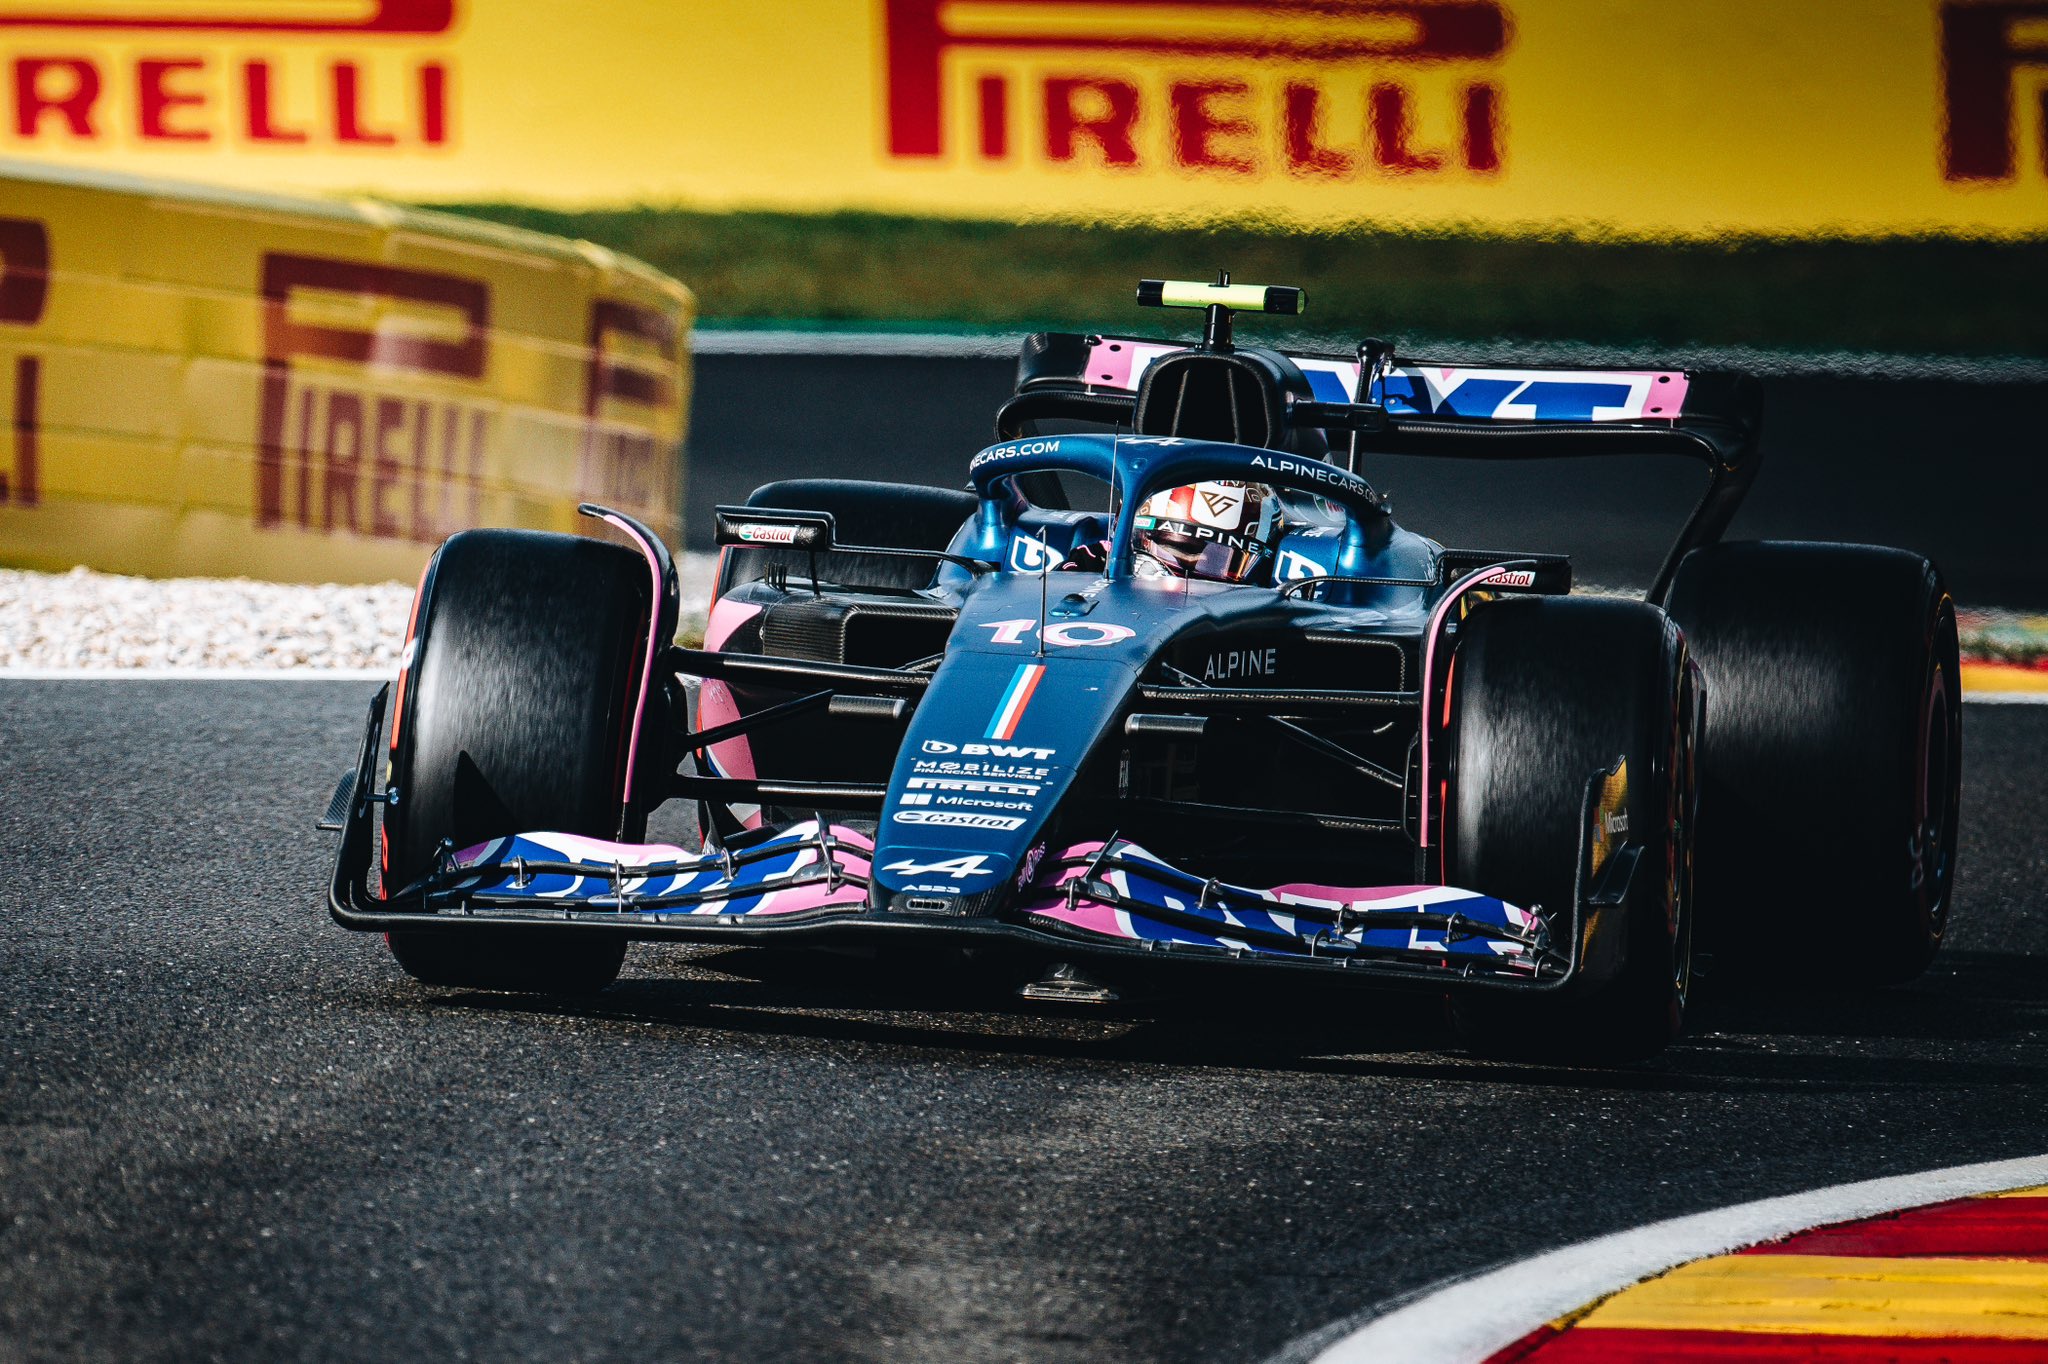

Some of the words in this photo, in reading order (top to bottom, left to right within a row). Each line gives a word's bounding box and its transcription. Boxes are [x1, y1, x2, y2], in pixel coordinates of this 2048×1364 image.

[886, 0, 1512, 174] PIRELLI
[258, 251, 491, 545] PIRELLI
[752, 527, 793, 541] Castrol
[1157, 520, 1261, 554] ALPINE
[978, 618, 1137, 648] 10
[1204, 648, 1277, 681] ALPINE
[961, 743, 1056, 760] BWT
[913, 767, 980, 776] FINANCIAL
[982, 771, 1043, 781] SERVICES
[906, 777, 1042, 797] PIRELLI
[936, 796, 1034, 812] Microsoft
[924, 813, 1015, 829] Castrol
[901, 884, 961, 894] A523
